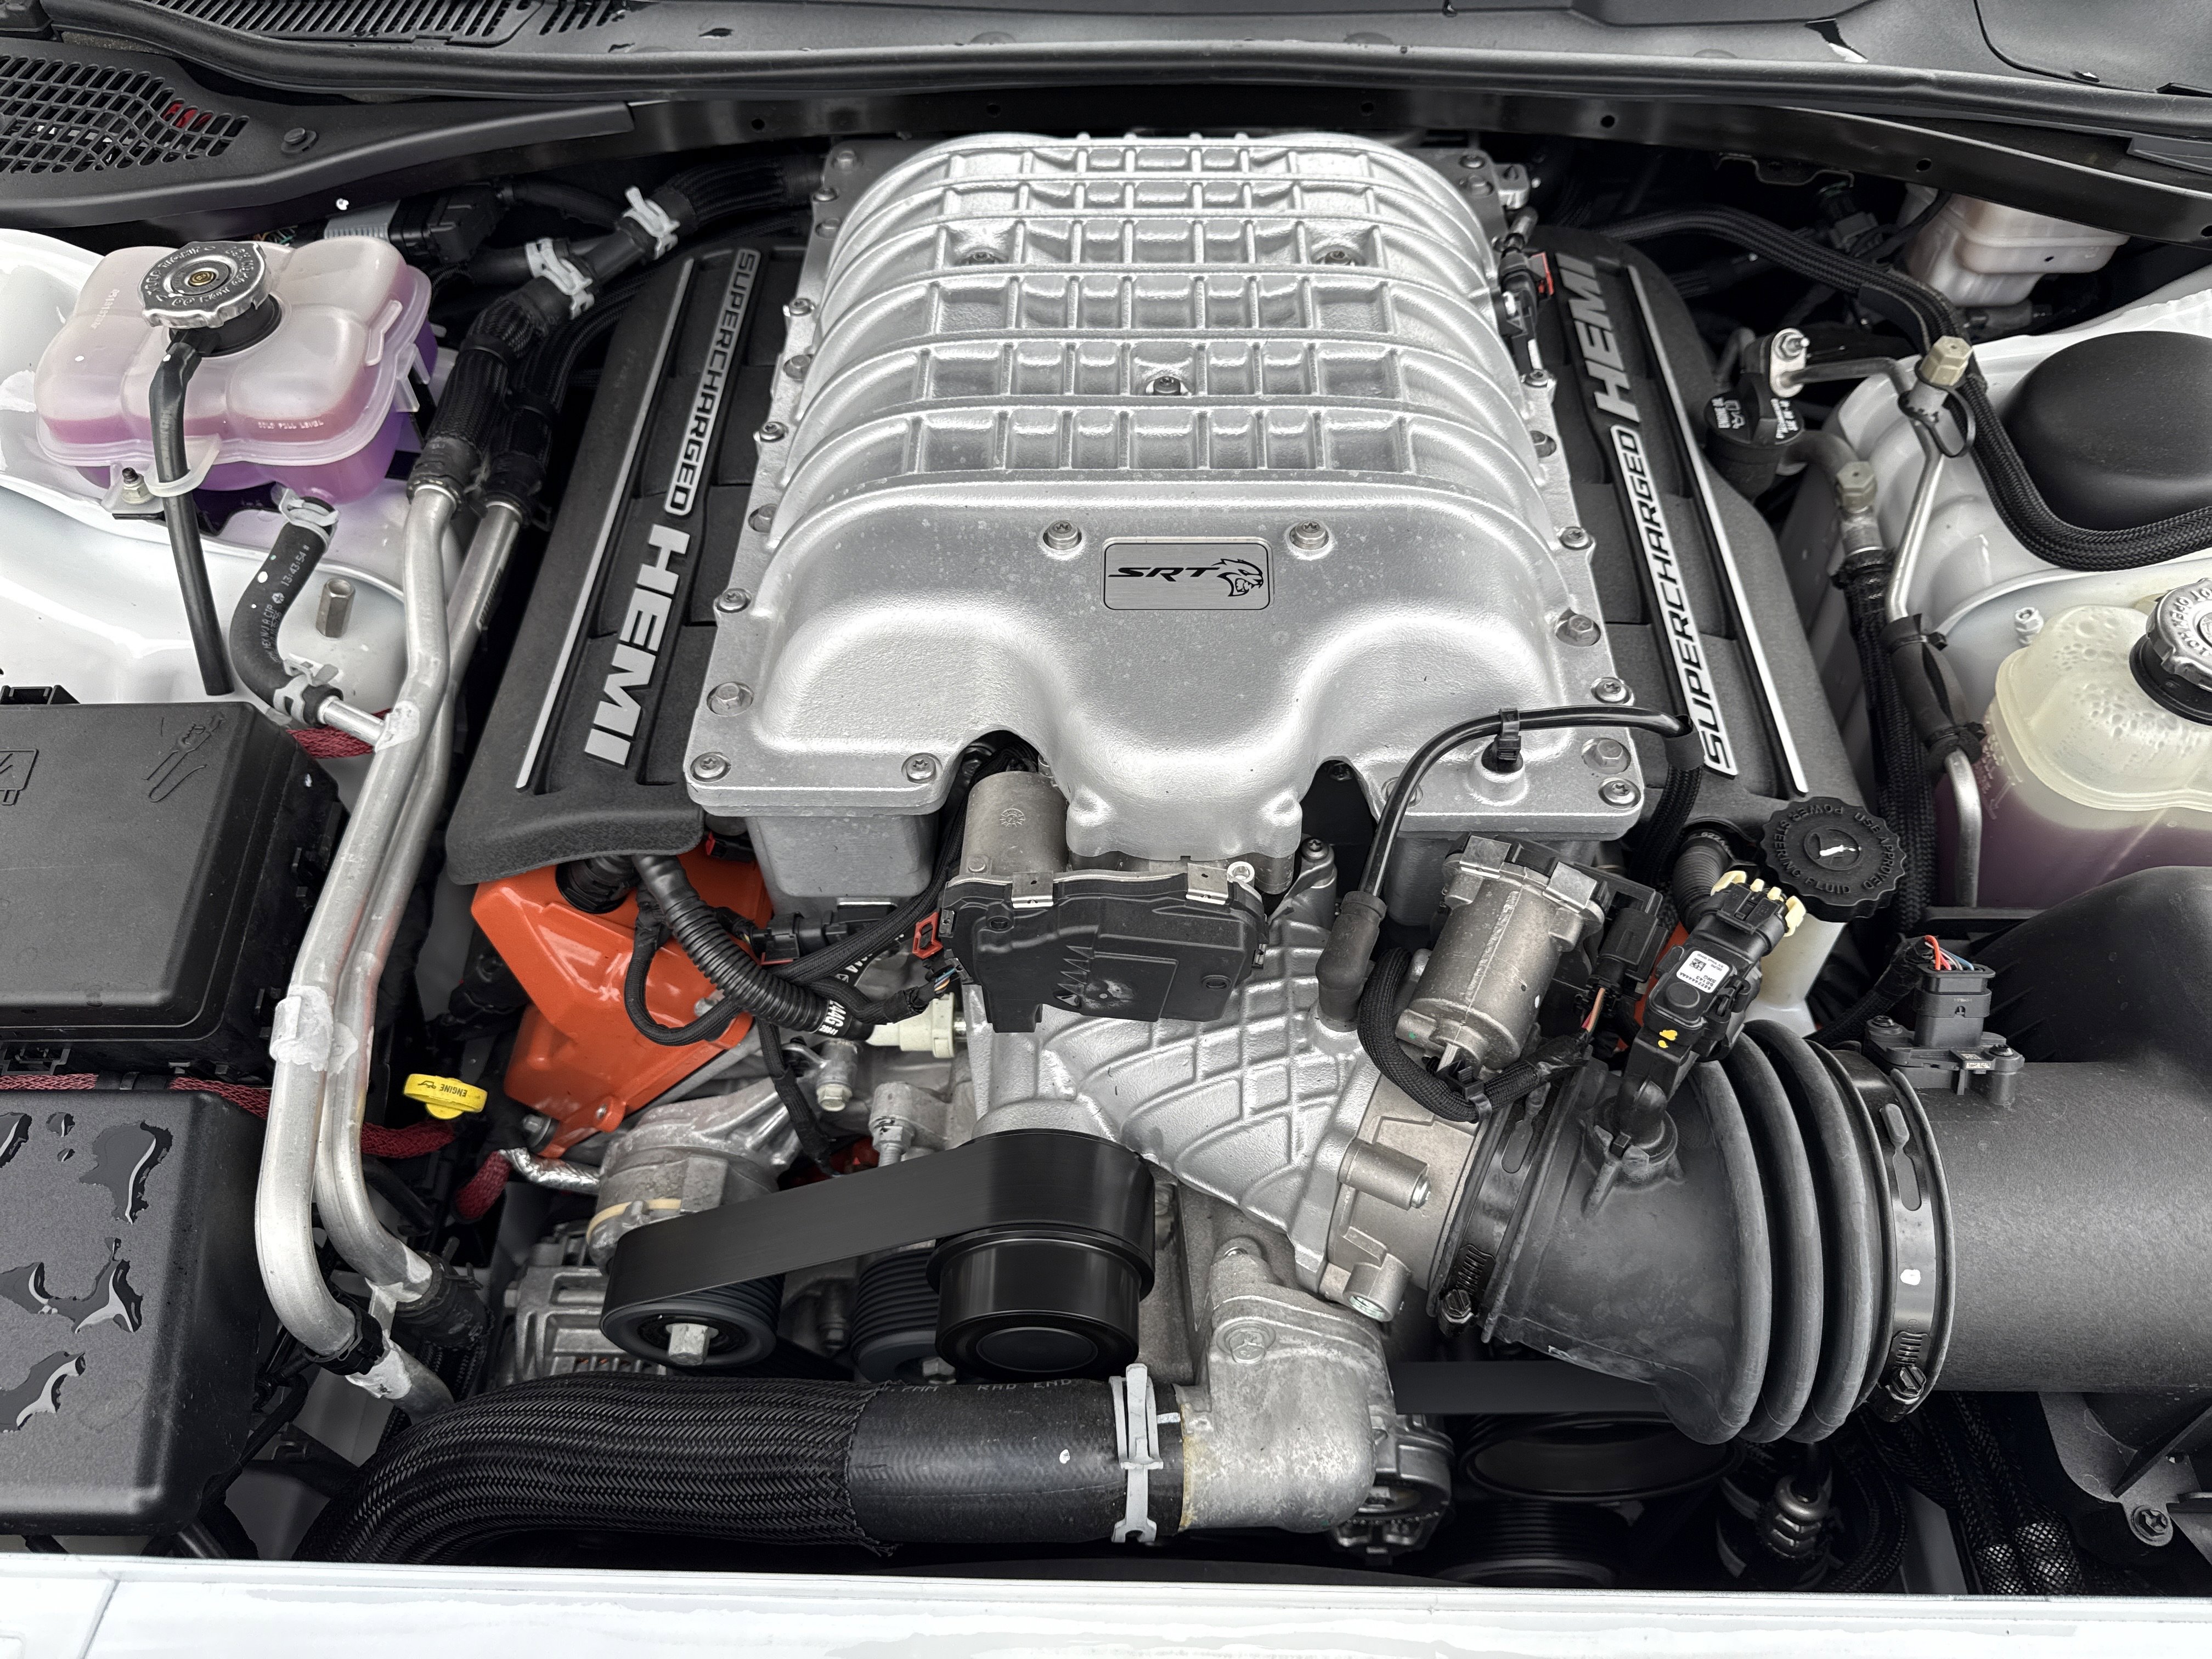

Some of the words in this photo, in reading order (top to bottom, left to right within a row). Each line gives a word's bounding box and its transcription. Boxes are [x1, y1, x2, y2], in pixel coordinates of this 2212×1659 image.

[1556, 253, 1641, 422] HEMI
[672, 252, 757, 510] SUPERCHARGED
[1108, 566, 1220, 582] SRT
[1618, 431, 1731, 769] SUPERCHARGED
[585, 524, 691, 768] HEMI
[1788, 804, 1843, 822] POWER
[1854, 812, 1881, 834] USE
[1774, 819, 1802, 878] STEERING
[1863, 836, 1895, 889] APPROVED
[1804, 877, 1851, 894] FLUID
[439, 1084, 468, 1098] ENGINE
[1033, 1378, 1073, 1389] END
